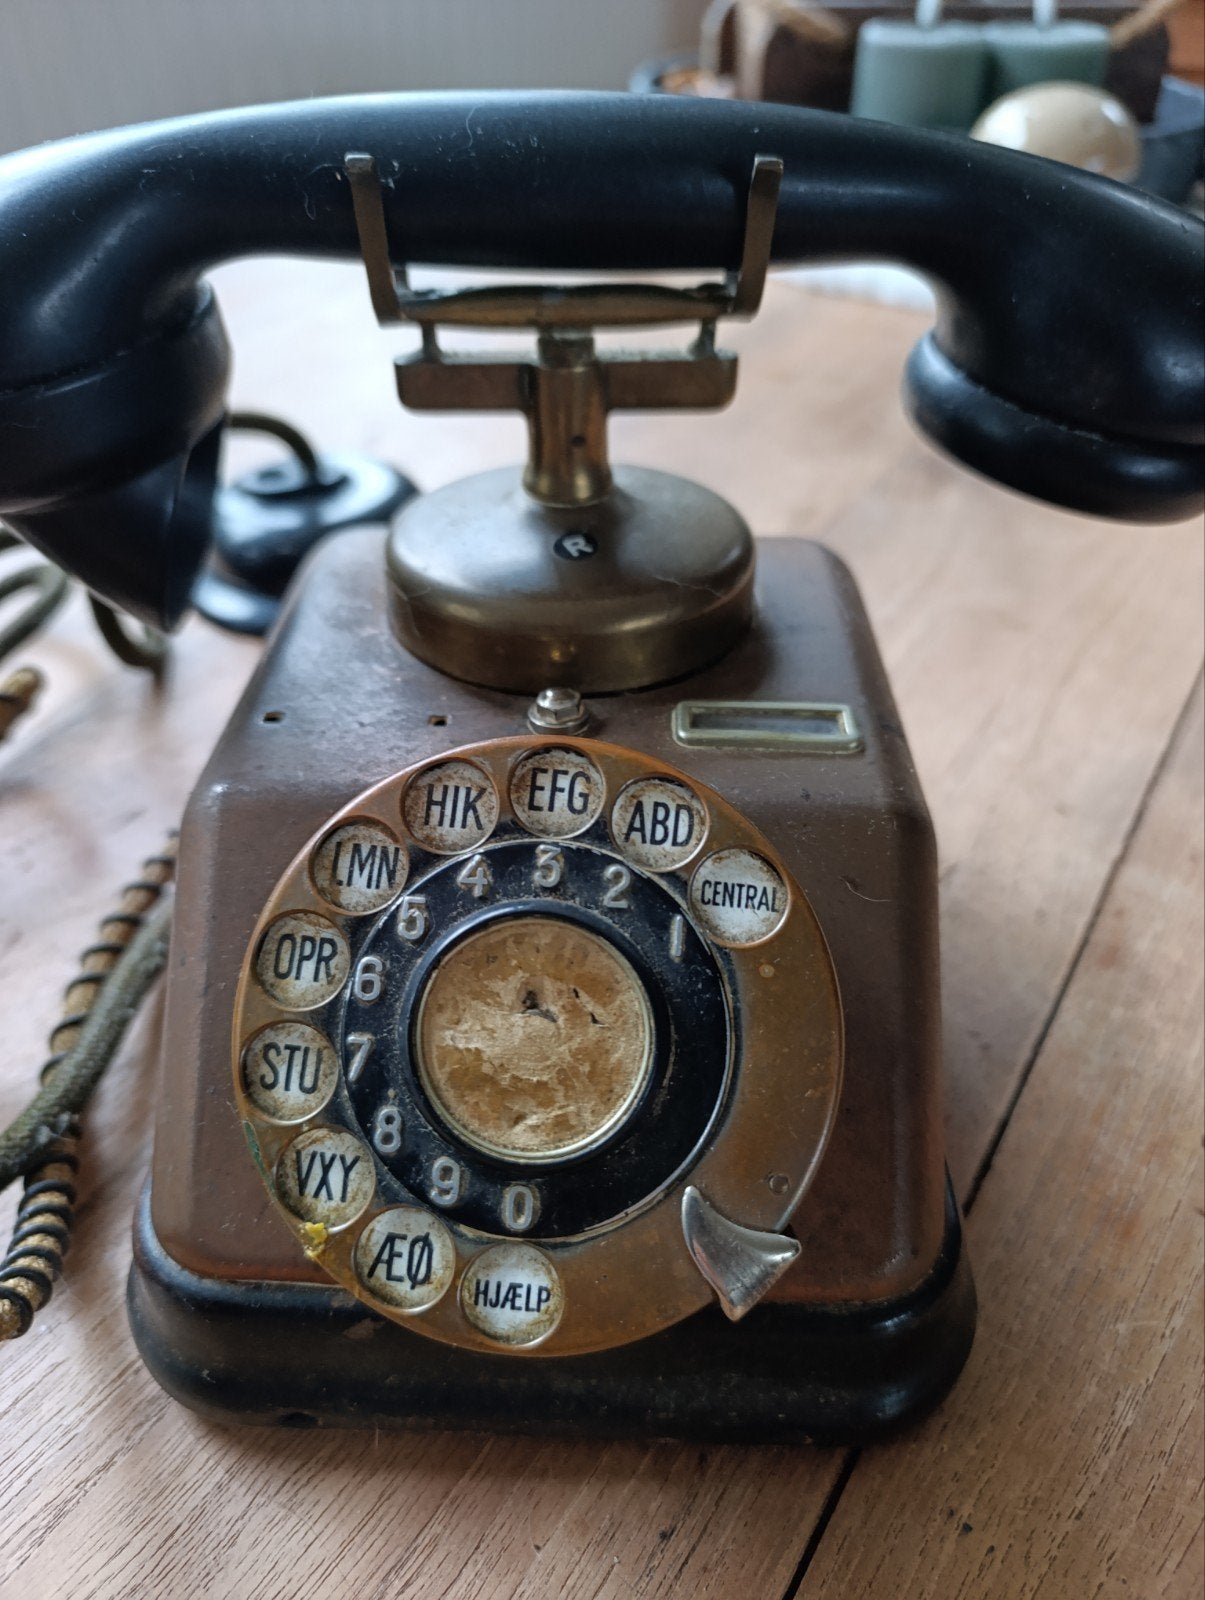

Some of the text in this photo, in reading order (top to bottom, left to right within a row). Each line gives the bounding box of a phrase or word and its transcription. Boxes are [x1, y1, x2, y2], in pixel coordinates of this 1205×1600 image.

[562, 534, 594, 557] R
[424, 783, 487, 830] HIK
[527, 767, 591, 815] EFG
[624, 800, 694, 847] ABD
[330, 841, 400, 889] LMN
[456, 854, 488, 898] 4
[533, 845, 561, 887] 3
[603, 864, 631, 909] 2
[398, 895, 426, 940] 5
[701, 879, 779, 913] CENTRAL
[273, 933, 338, 983] OPR
[670, 914, 684, 959] 1
[354, 956, 383, 1000] 6
[260, 1042, 322, 1094] STU
[346, 1035, 372, 1081] 7
[373, 1105, 401, 1152] 8
[296, 1149, 360, 1203] VXY
[430, 1156, 461, 1206] 9
[503, 1184, 534, 1231] 0
[367, 1232, 434, 1290] ÆØ
[473, 1279, 551, 1313] HJÆLP
